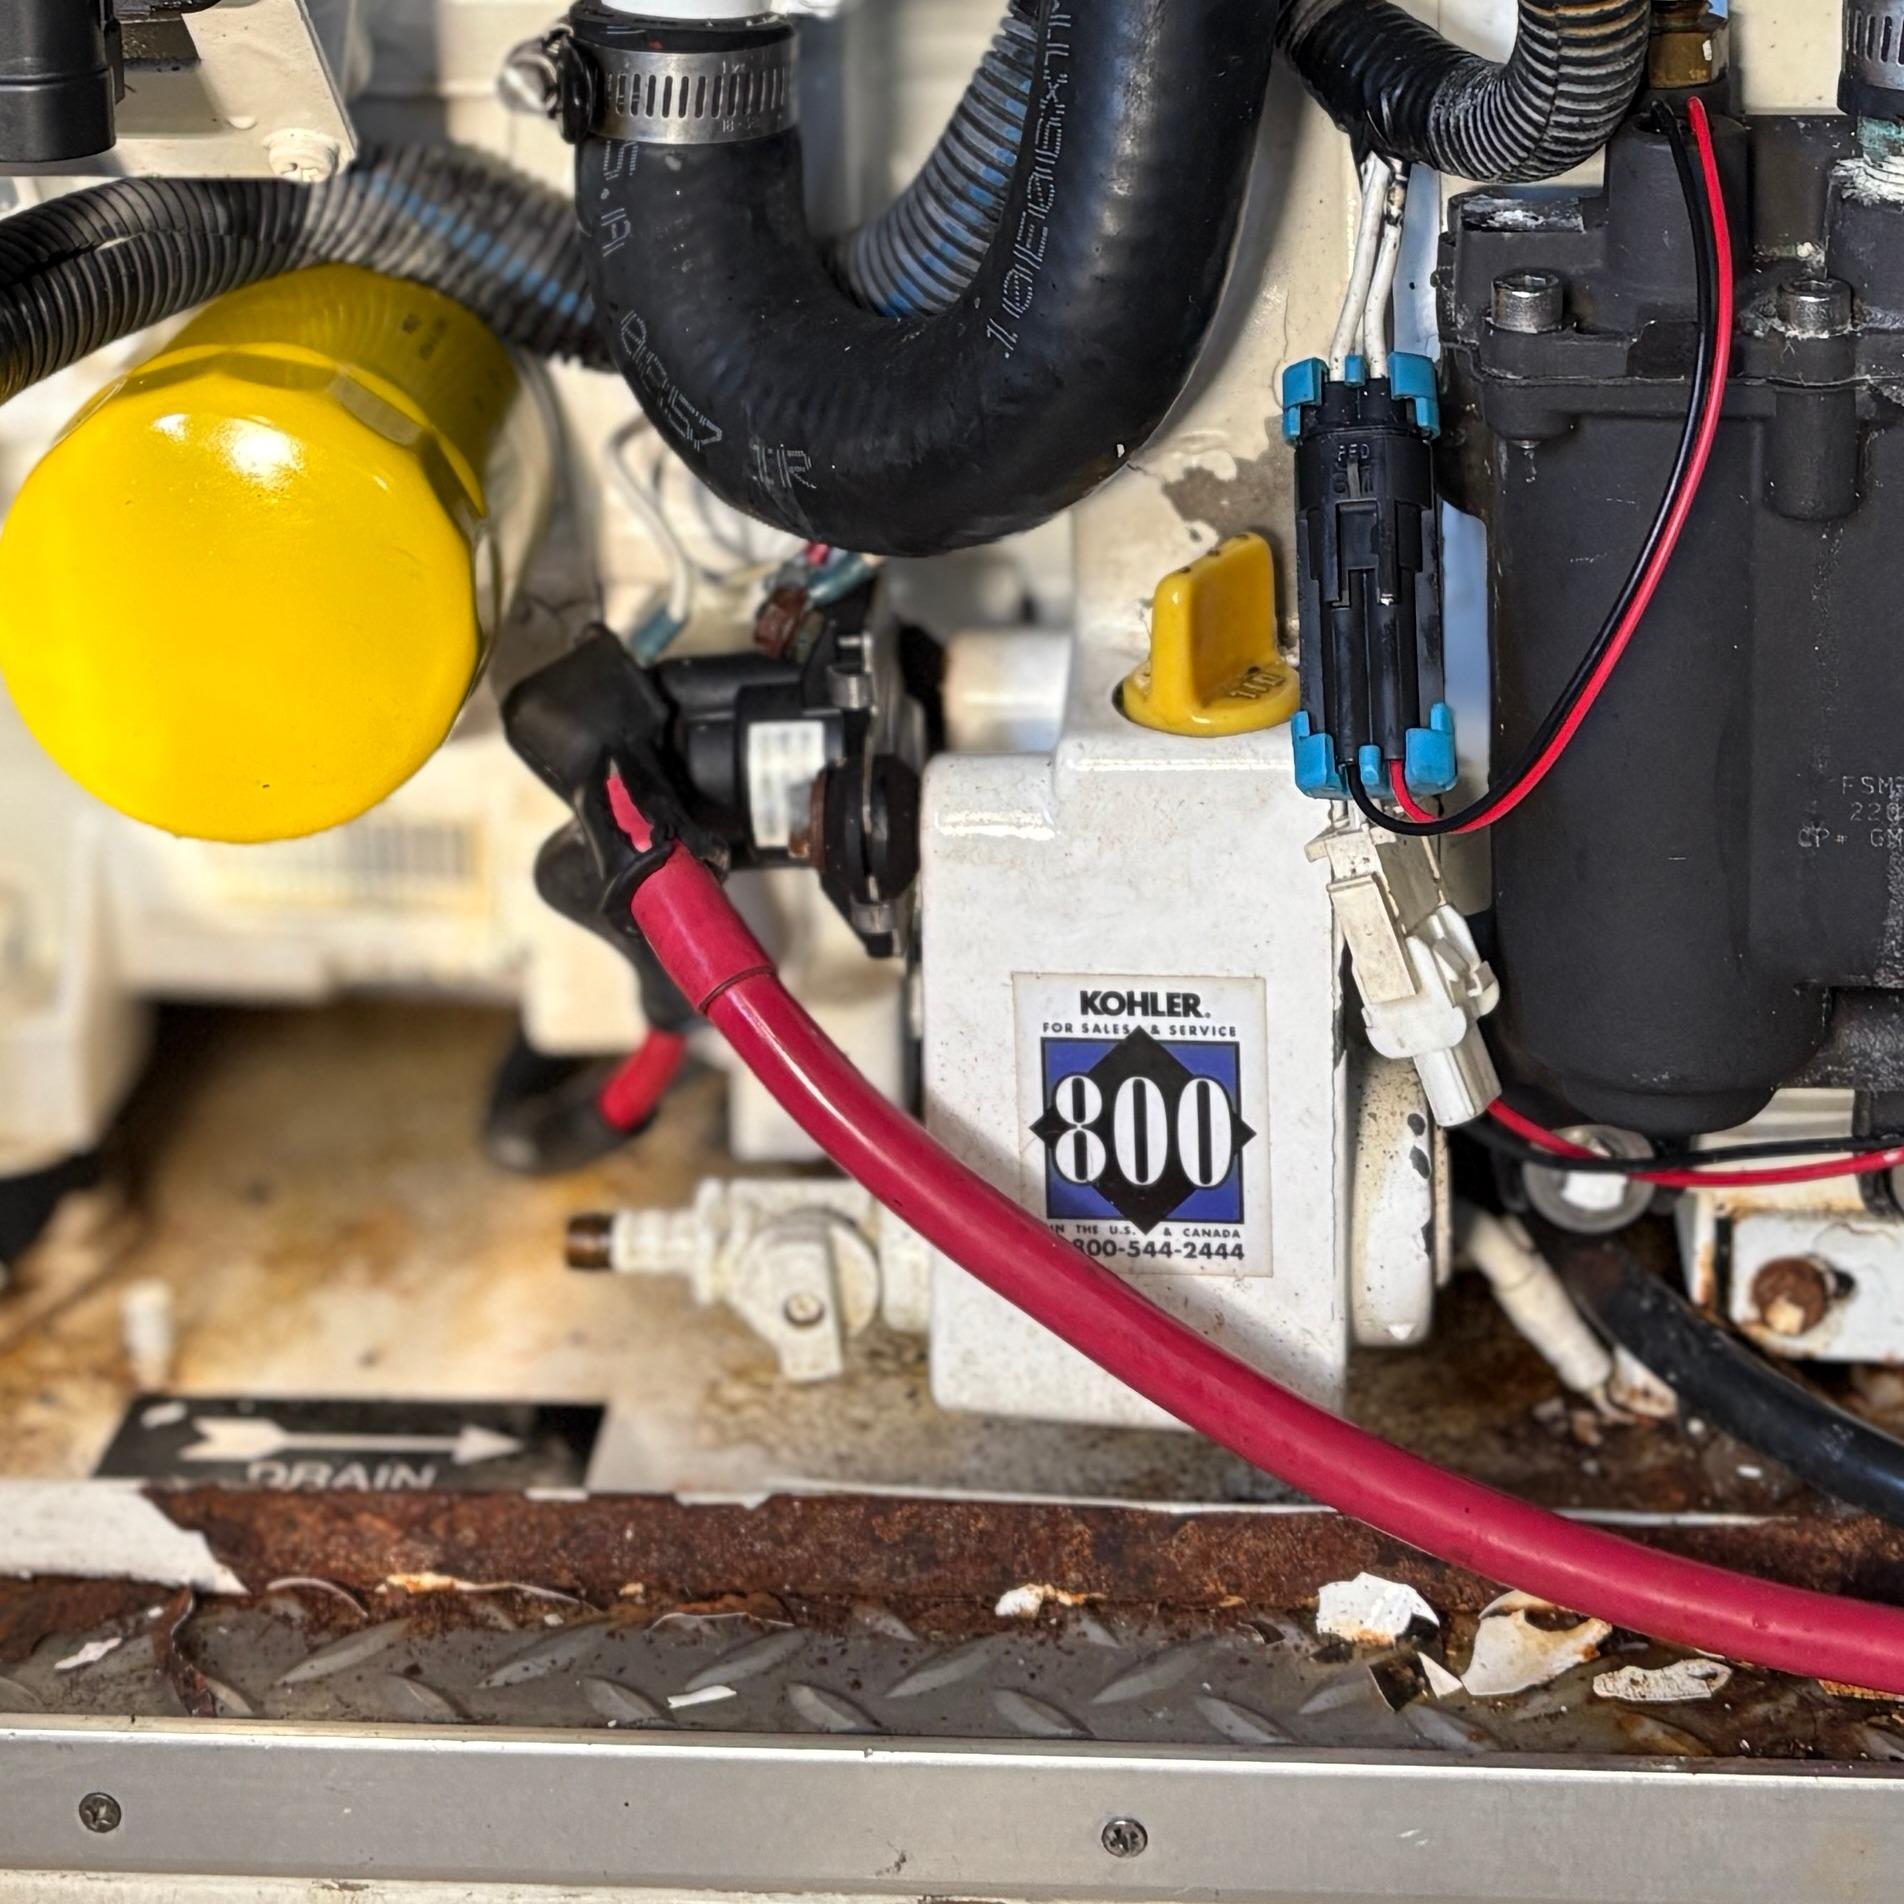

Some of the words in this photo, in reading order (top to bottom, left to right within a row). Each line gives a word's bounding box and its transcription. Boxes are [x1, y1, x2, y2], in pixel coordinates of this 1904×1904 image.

[1043, 1022, 1074, 1034] FOR
[1082, 1023, 1130, 1035] SALES
[1150, 1024, 1160, 1035] &
[1169, 1025, 1237, 1037] SERVICE
[1055, 1075, 1232, 1187] 800
[1076, 1225, 1099, 1234] THE
[1109, 1226, 1136, 1235] U.S.
[1164, 1227, 1172, 1237] &
[1183, 1228, 1240, 1238] CANADA
[247, 1462, 437, 1490] DRAIN
